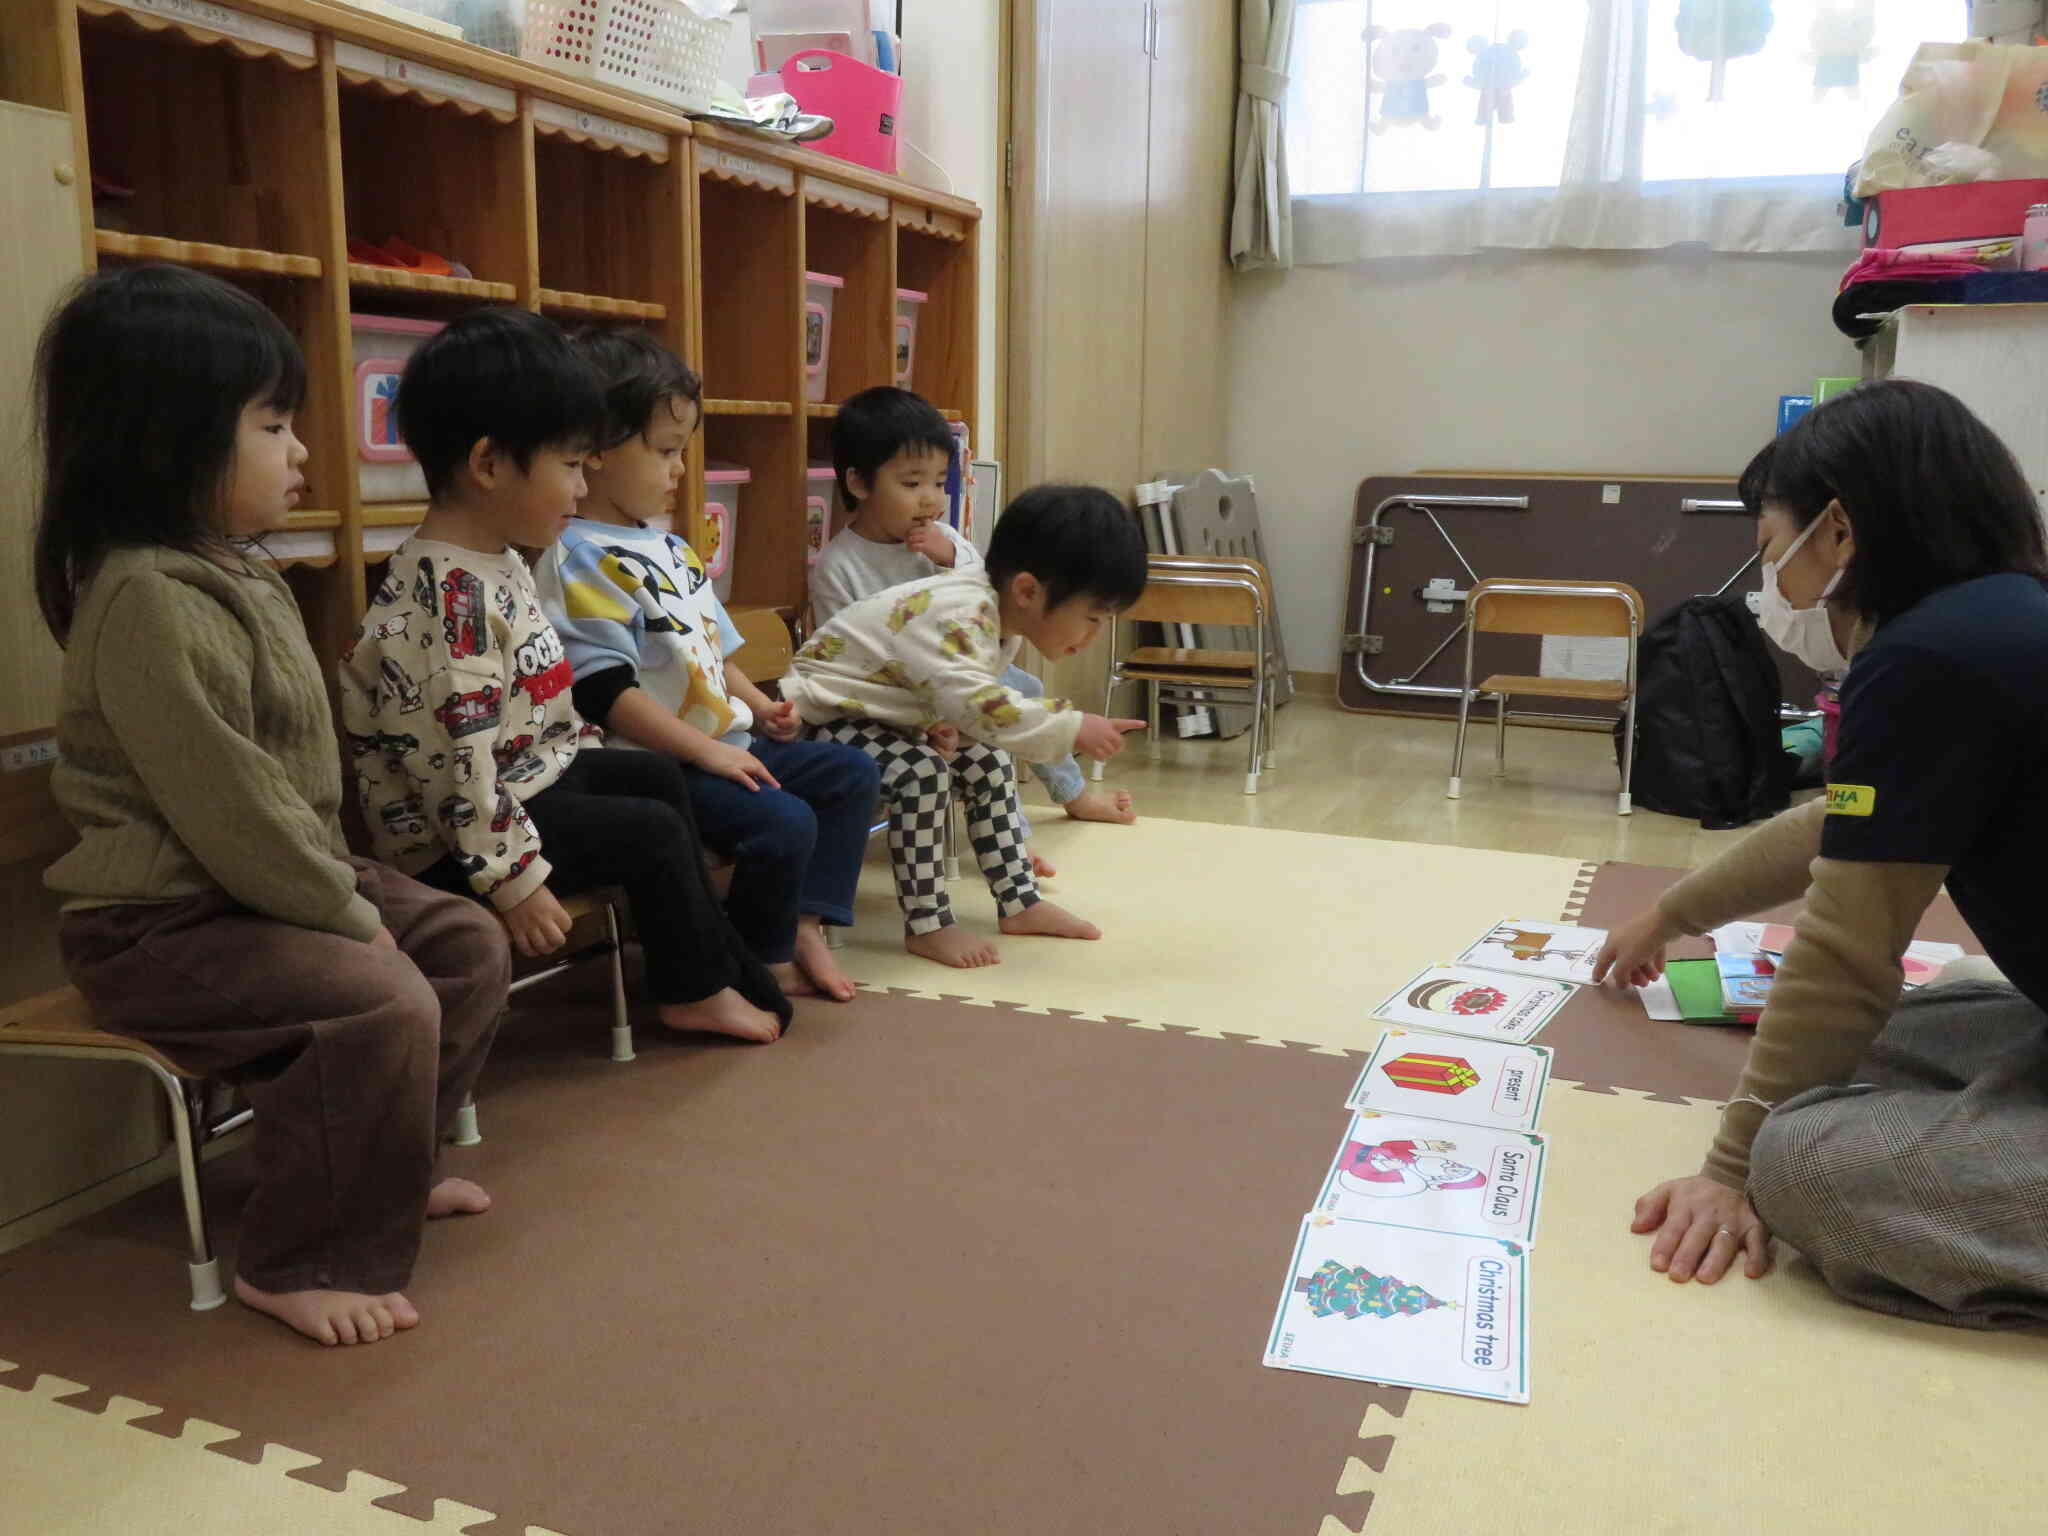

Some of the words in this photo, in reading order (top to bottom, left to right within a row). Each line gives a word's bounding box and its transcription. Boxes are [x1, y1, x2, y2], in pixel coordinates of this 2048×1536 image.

[1517, 990, 1554, 1017] Christmas
[1503, 1068, 1524, 1101] present
[1499, 1151, 1525, 1182] Santa
[1491, 1184, 1519, 1217] Claus
[1476, 1259, 1504, 1331] Christmas
[1473, 1334, 1501, 1366] tree
